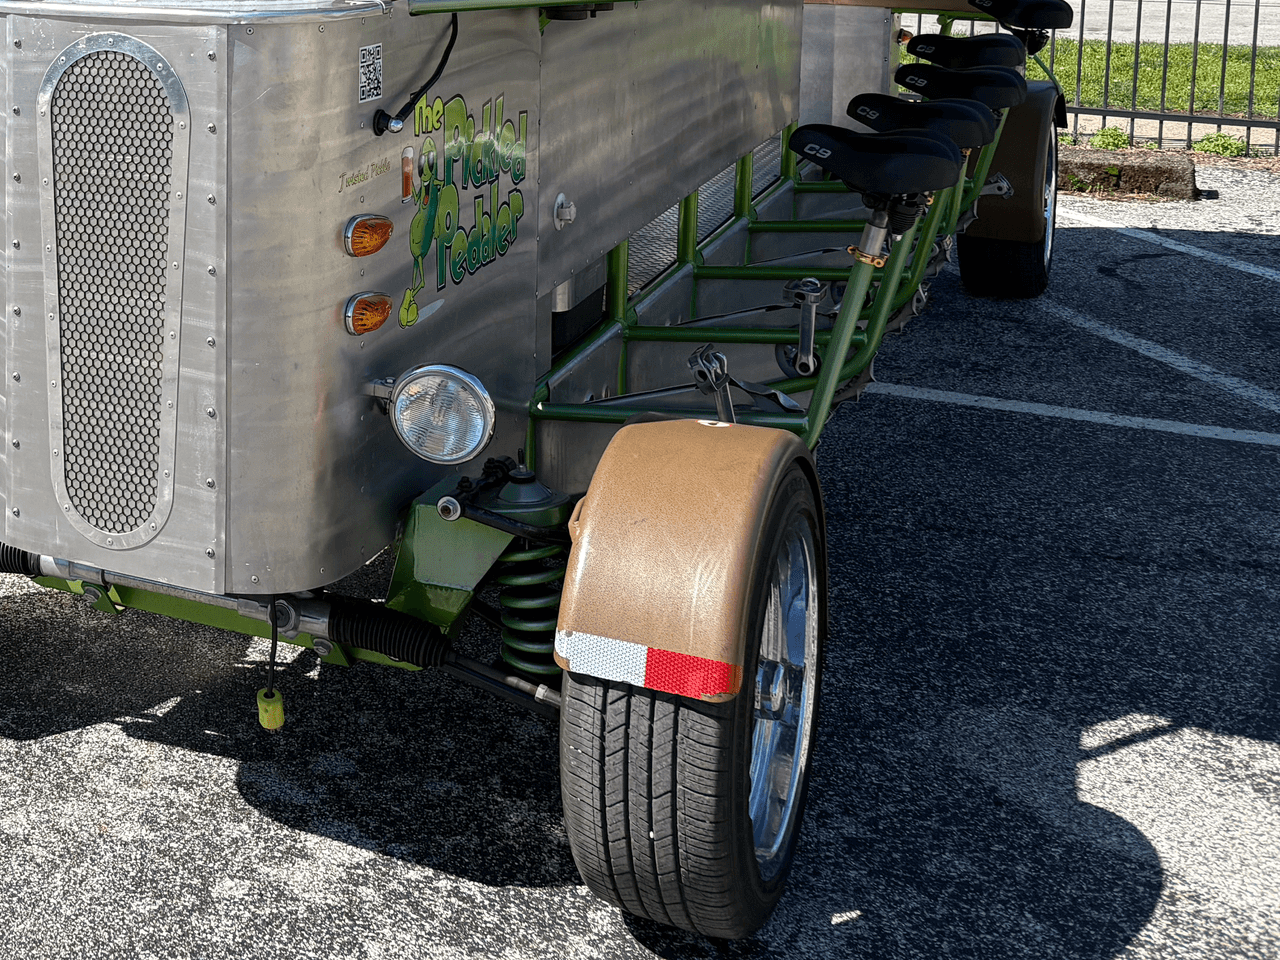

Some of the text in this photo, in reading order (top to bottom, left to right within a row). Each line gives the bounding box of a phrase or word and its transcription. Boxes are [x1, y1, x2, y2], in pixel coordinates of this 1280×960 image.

[905, 75, 928, 87] C9
[410, 91, 445, 137] The
[856, 105, 880, 120] C9
[443, 91, 529, 190] Pickled
[803, 143, 833, 160] C9
[436, 178, 525, 292] Pedaler
